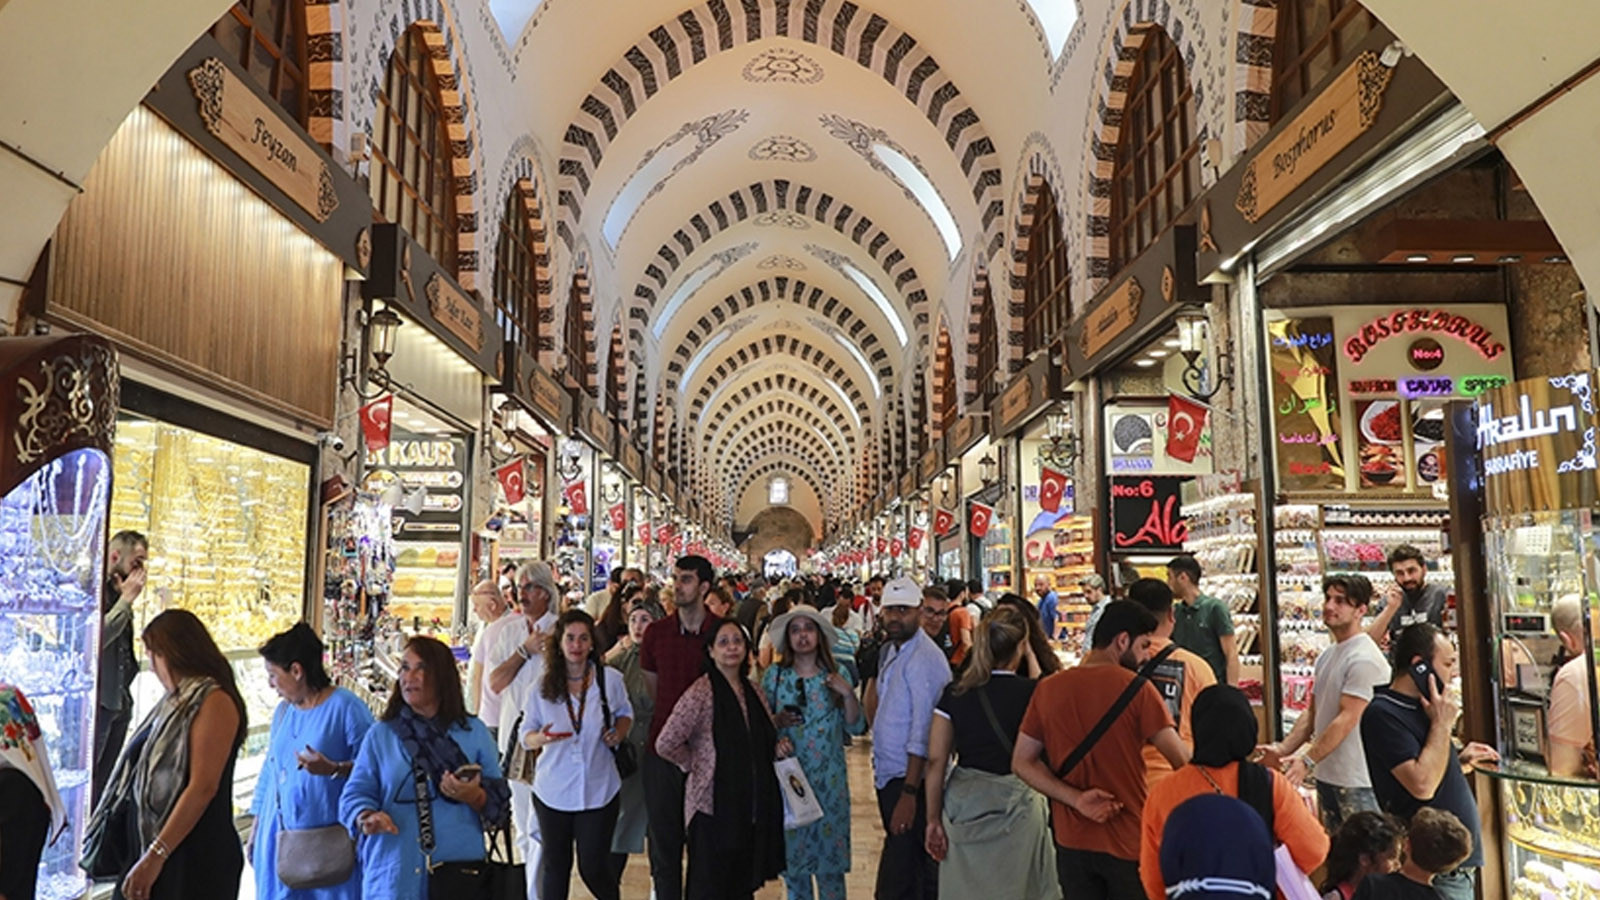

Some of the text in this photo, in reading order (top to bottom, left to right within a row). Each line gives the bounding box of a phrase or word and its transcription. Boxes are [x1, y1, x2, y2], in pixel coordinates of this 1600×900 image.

[250, 116, 297, 172] Feyzan
[1273, 108, 1336, 180] Bosphorus
[1412, 348, 1442, 361] No:4
[389, 440, 456, 466] KAUR
[1112, 480, 1155, 498] No:6
